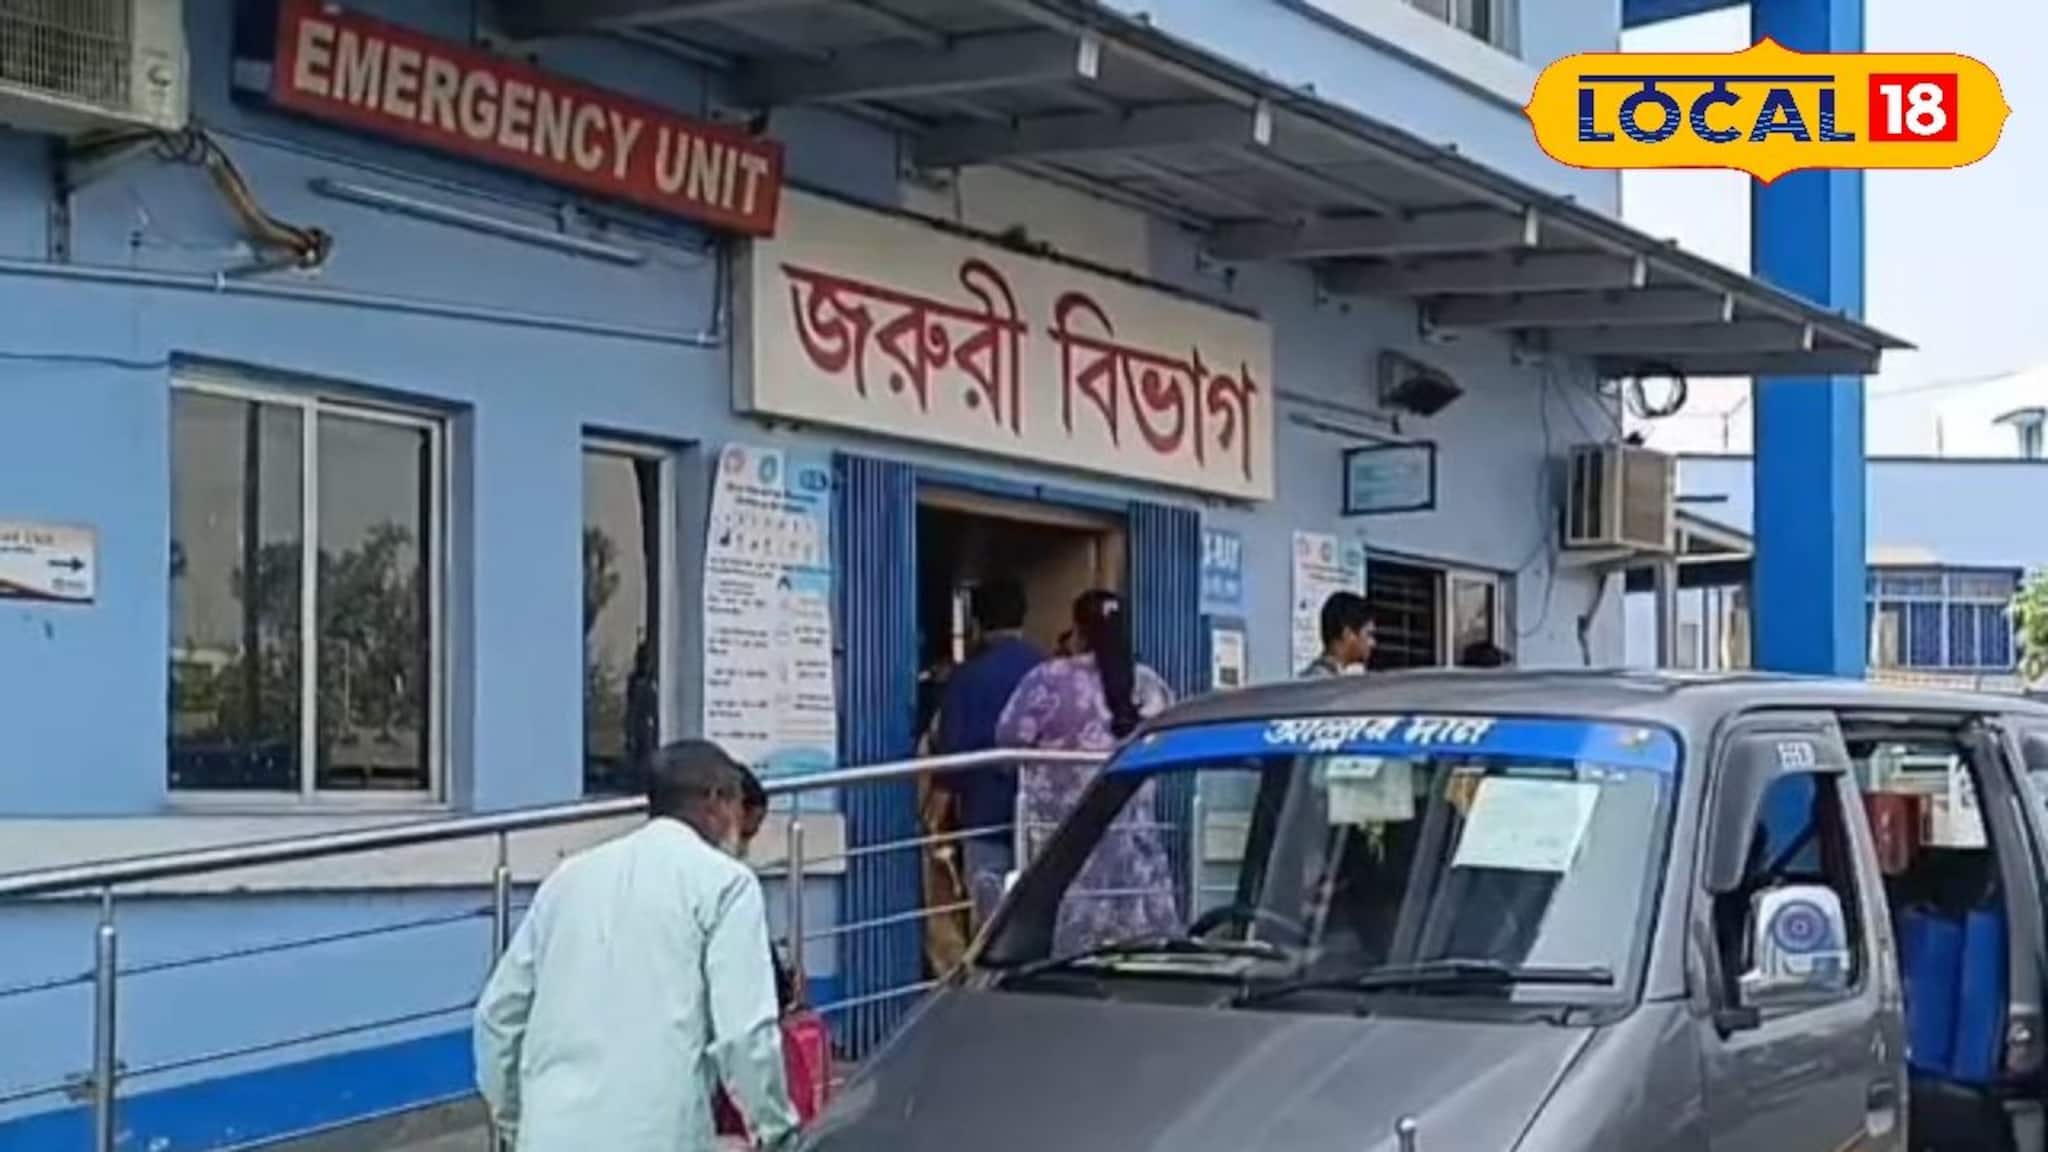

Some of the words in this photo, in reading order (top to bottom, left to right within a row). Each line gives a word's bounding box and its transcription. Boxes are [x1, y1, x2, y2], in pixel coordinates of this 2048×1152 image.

[292, 17, 644, 179] EMERGENCY
[654, 132, 770, 215] UNIT
[780, 257, 1028, 436] জরুরী
[1048, 291, 1257, 482] বিভাগ
